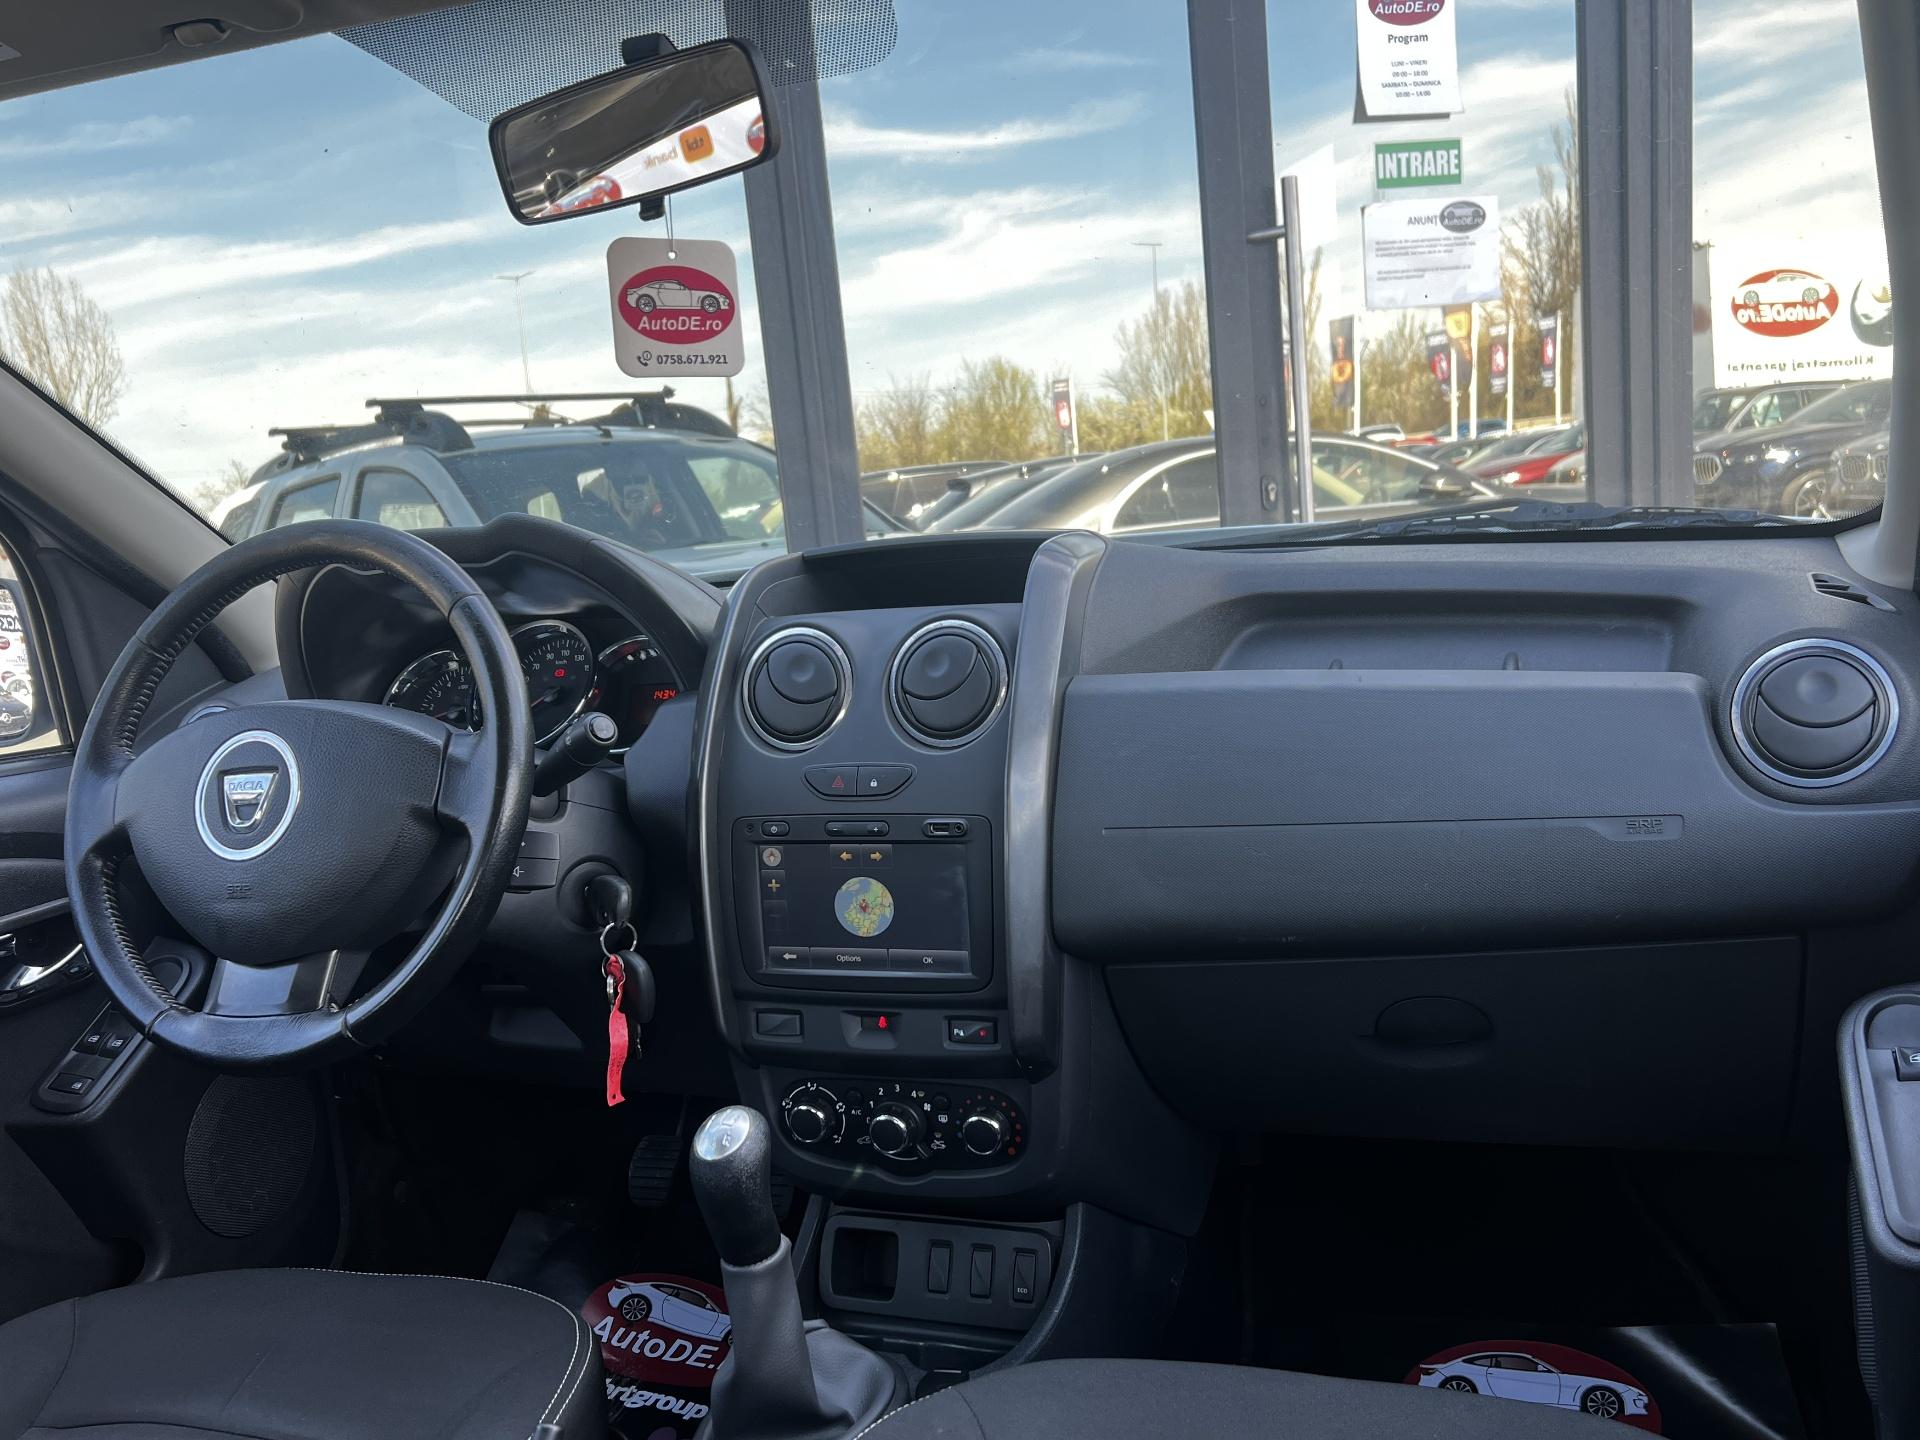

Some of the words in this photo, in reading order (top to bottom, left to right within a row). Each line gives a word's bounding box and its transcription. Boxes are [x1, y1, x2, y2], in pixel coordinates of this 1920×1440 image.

[1374, 1, 1440, 14] AutoDE.ro
[1387, 34, 1429, 45] Program
[1377, 149, 1460, 179] INTRARE
[637, 316, 723, 331] AutoDE.ro
[657, 354, 729, 365] 0758.671.921
[546, 653, 555, 661] 90
[574, 654, 585, 662] 130
[532, 663, 540, 671] 70
[228, 781, 264, 792] DACIA
[836, 954, 862, 962] Options
[922, 956, 933, 964] OK
[895, 1084, 900, 1092] 3
[593, 1315, 725, 1370] AutoDE.
